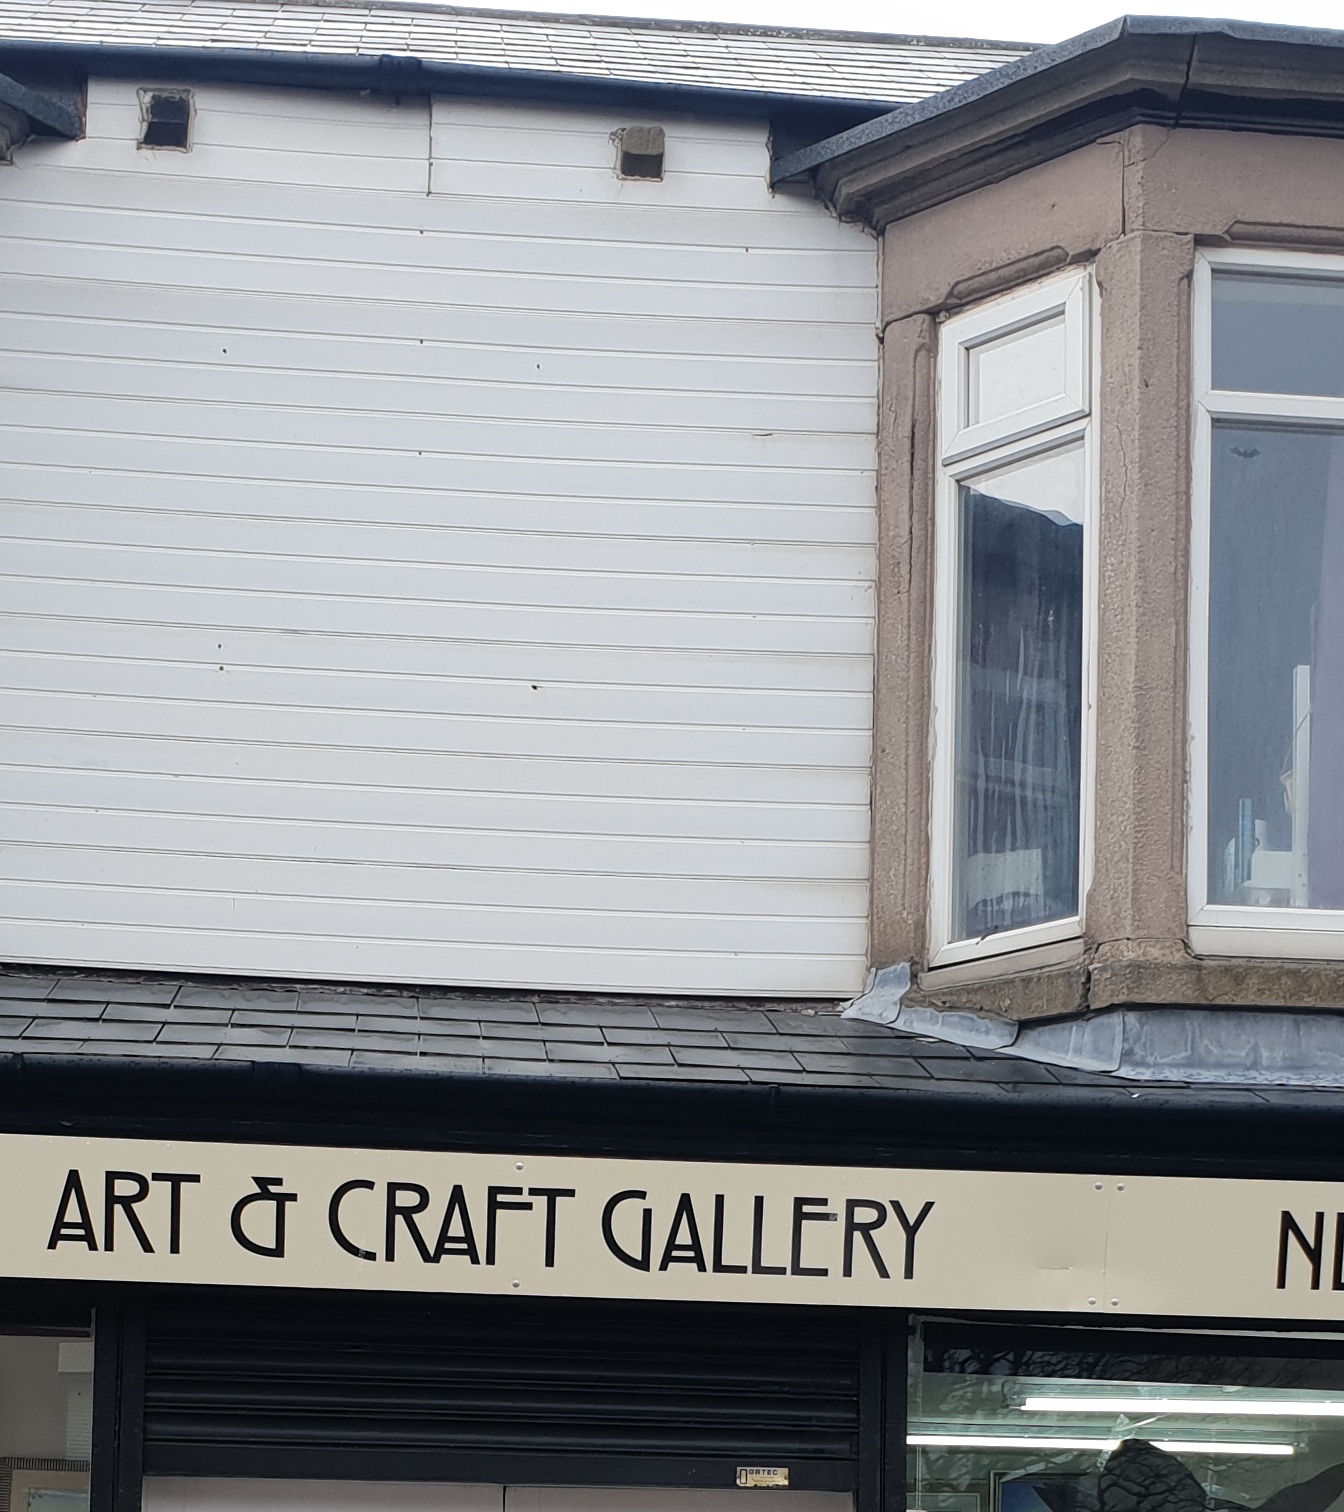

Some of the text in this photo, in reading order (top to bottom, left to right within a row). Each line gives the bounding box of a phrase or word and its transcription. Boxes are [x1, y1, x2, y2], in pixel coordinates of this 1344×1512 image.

[47, 1169, 935, 1280] ART & CRAFT GALLERY
